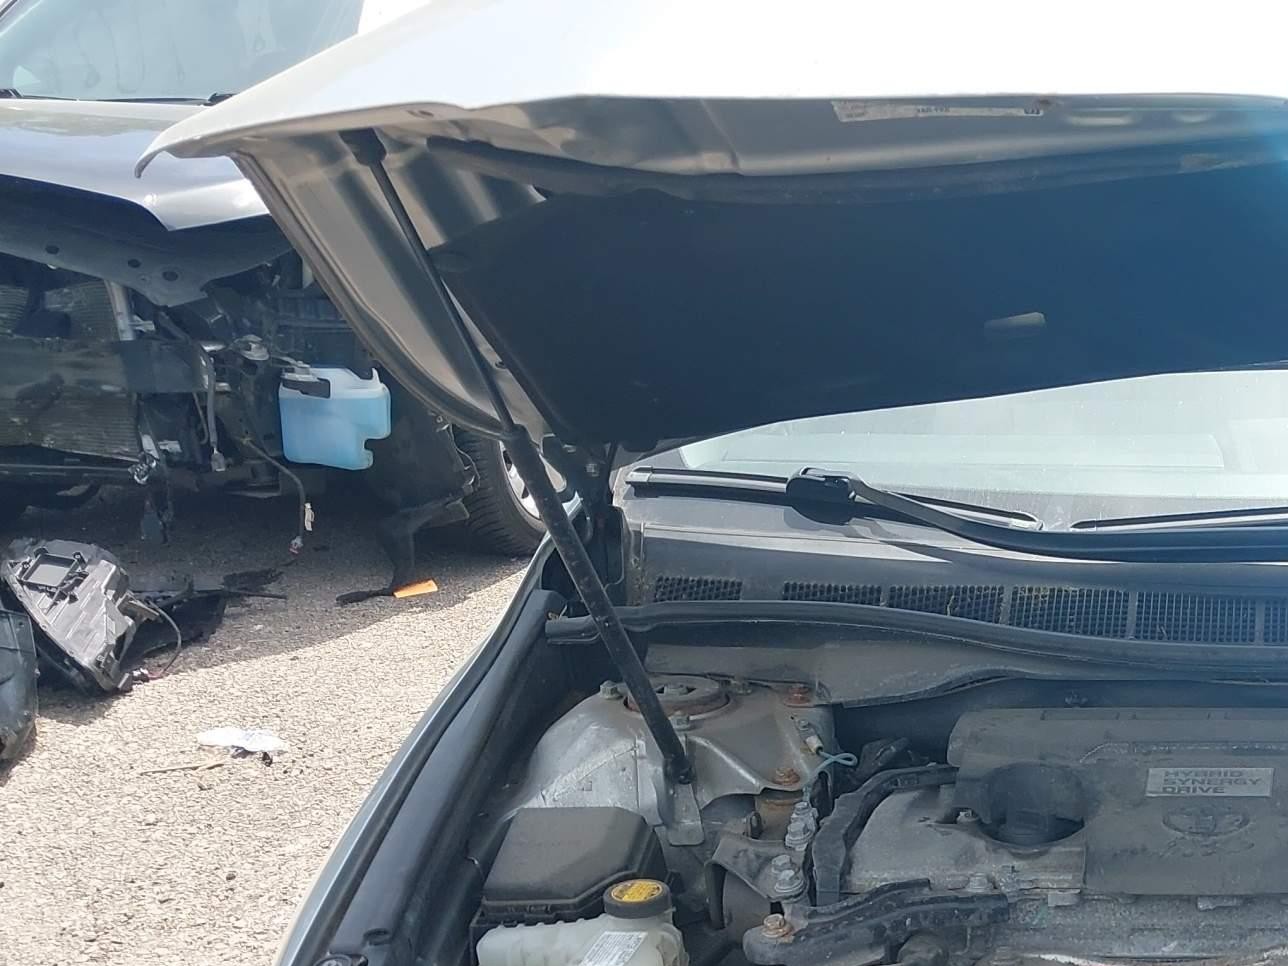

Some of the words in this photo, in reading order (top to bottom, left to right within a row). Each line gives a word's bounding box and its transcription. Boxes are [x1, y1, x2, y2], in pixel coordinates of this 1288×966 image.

[1164, 770, 1243, 778] HYBRID
[1163, 778, 1263, 786] SYNERGY
[1162, 786, 1226, 794] DRIVE
